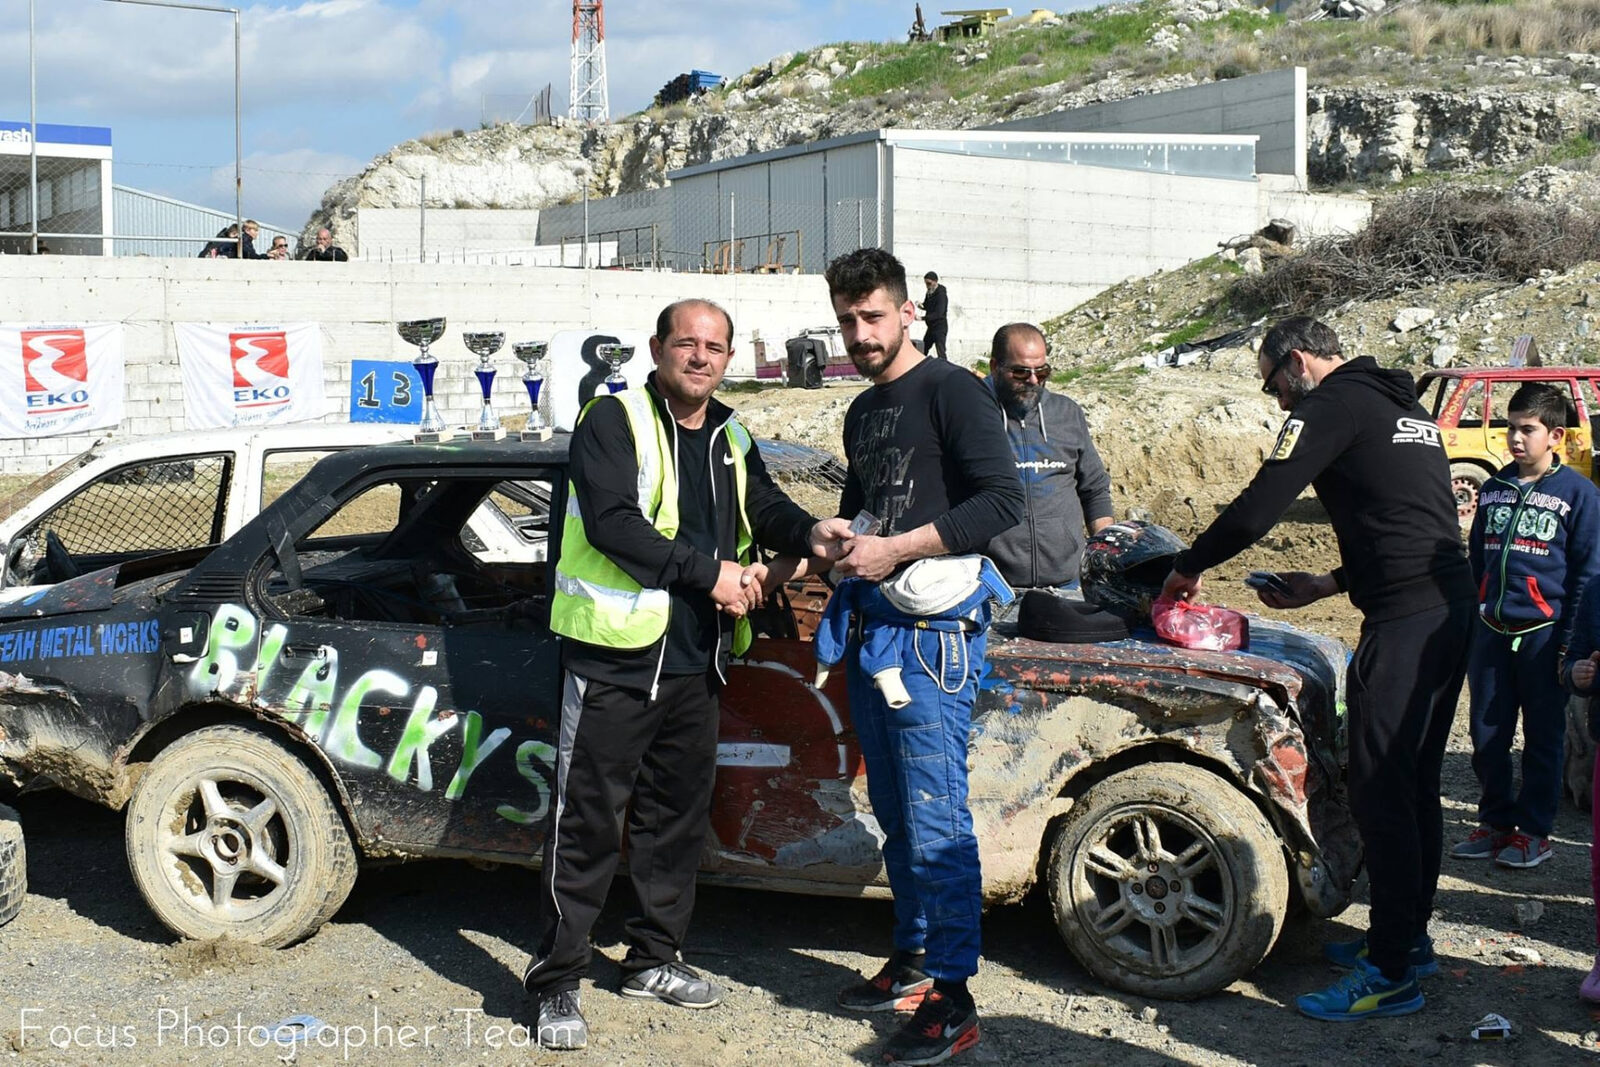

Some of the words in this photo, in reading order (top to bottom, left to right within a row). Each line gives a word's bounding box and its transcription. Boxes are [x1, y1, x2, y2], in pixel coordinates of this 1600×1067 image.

[27, 390, 89, 408] EKO
[234, 385, 290, 402] EKO
[39, 626, 95, 659] METAL
[100, 619, 160, 655] WORKS
